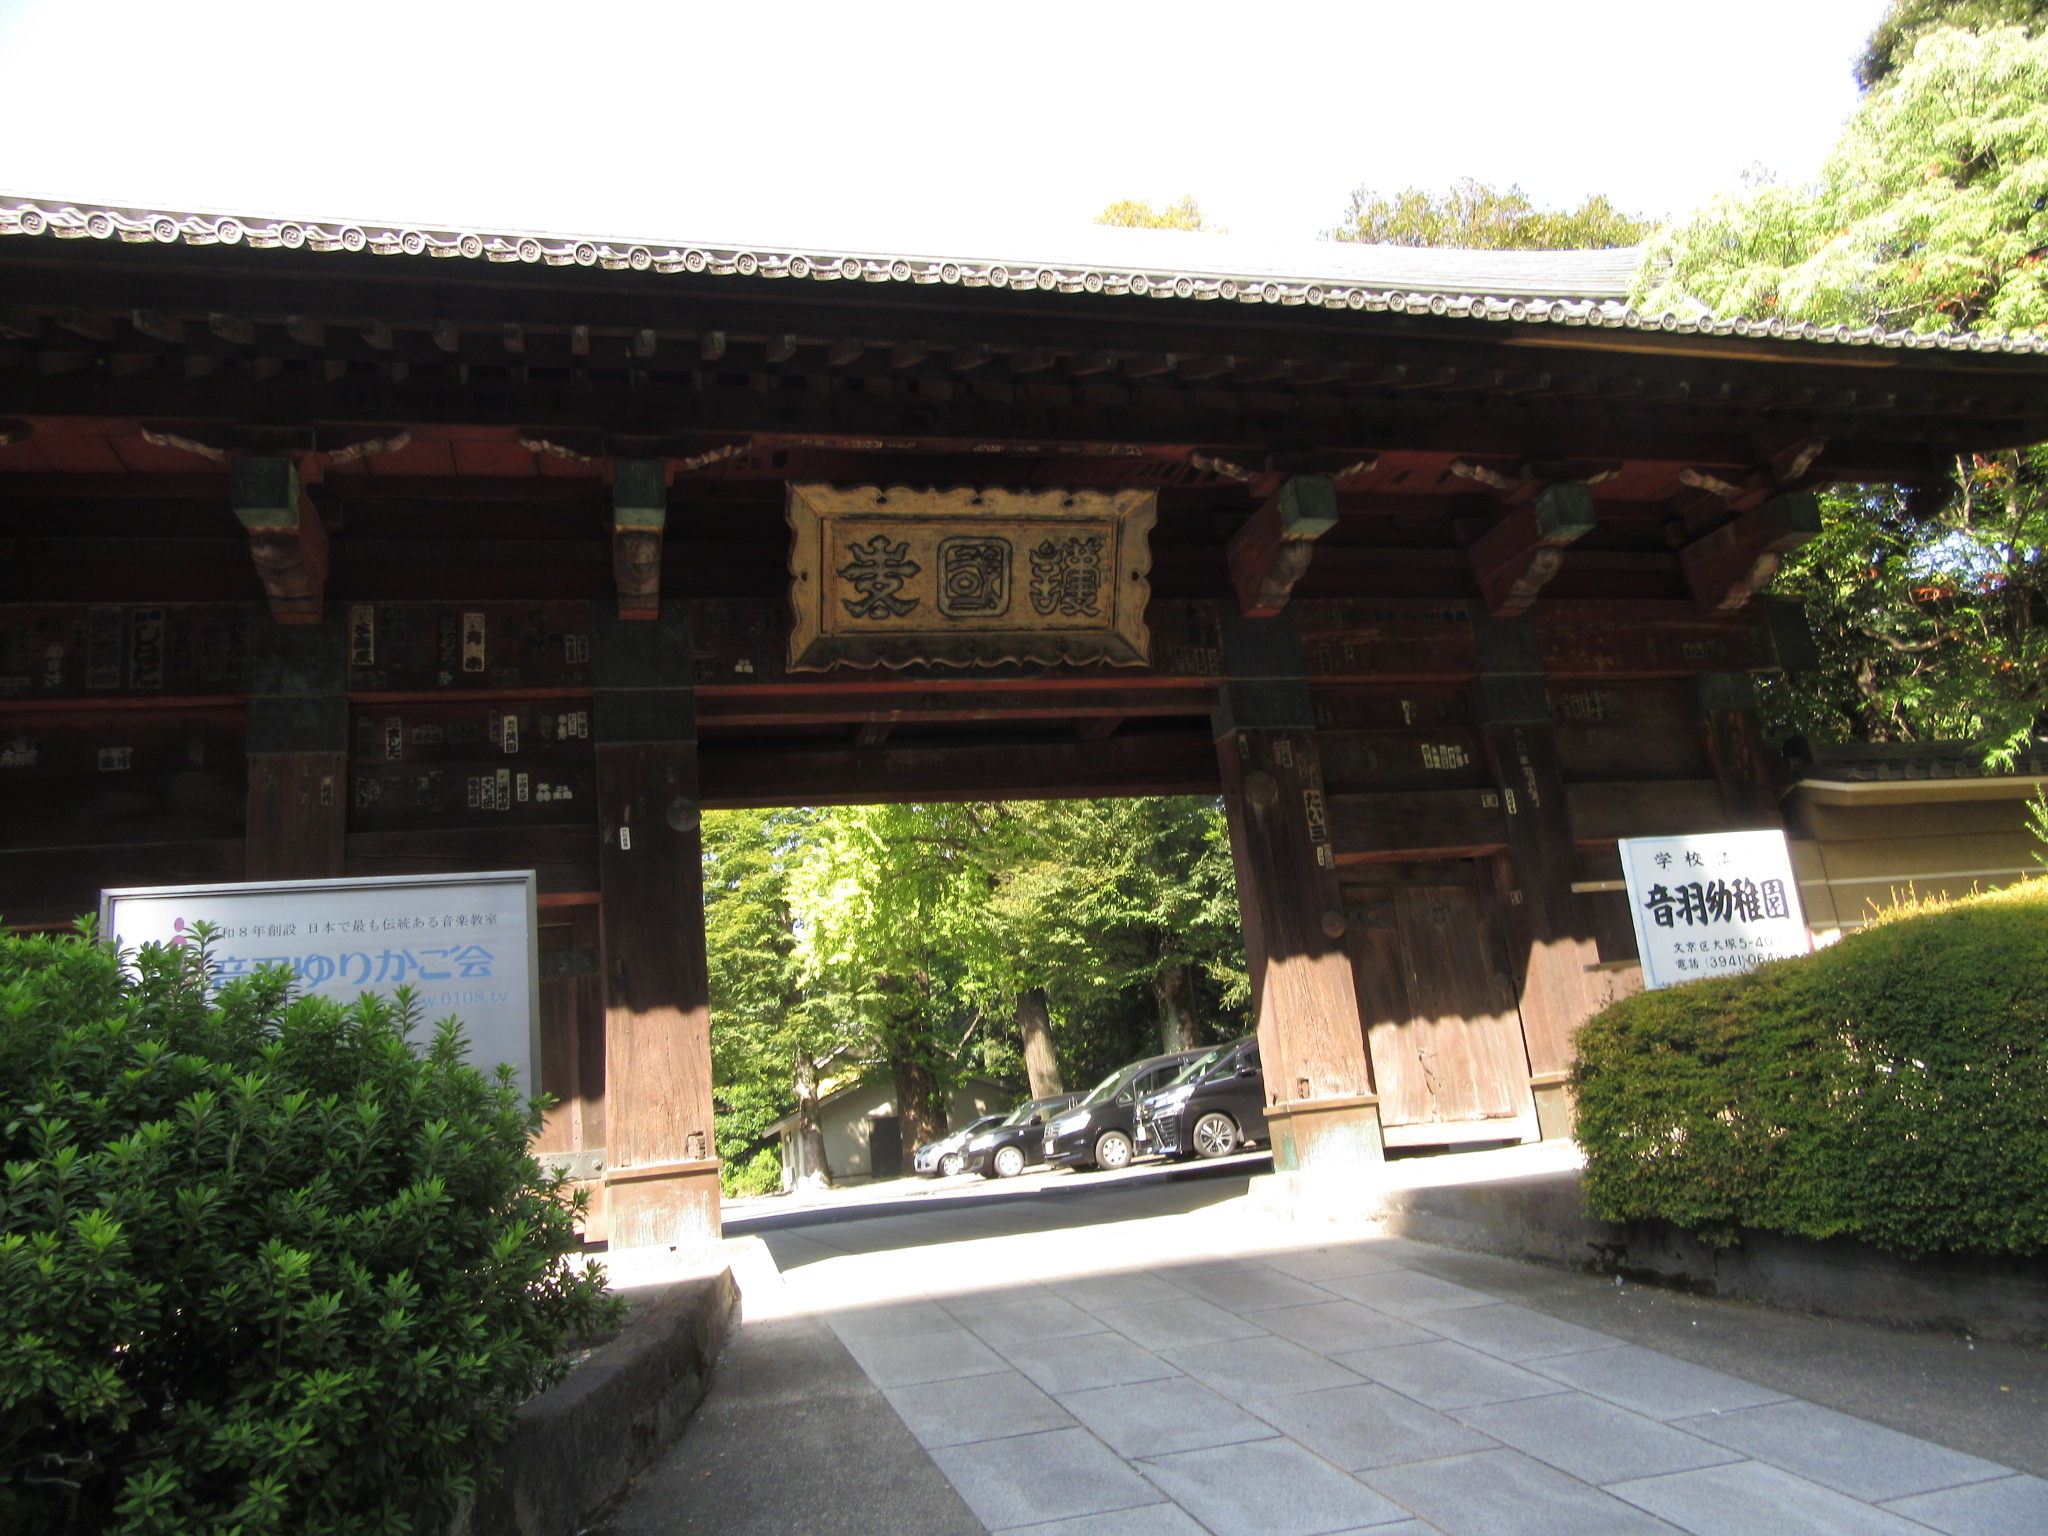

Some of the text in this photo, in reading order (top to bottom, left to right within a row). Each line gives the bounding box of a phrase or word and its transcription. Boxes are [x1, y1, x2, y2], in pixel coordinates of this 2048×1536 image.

[1643, 876, 1789, 929] 音羽幼稚園
[308, 912, 499, 935] 日本で最も伝統ある音楽教室
